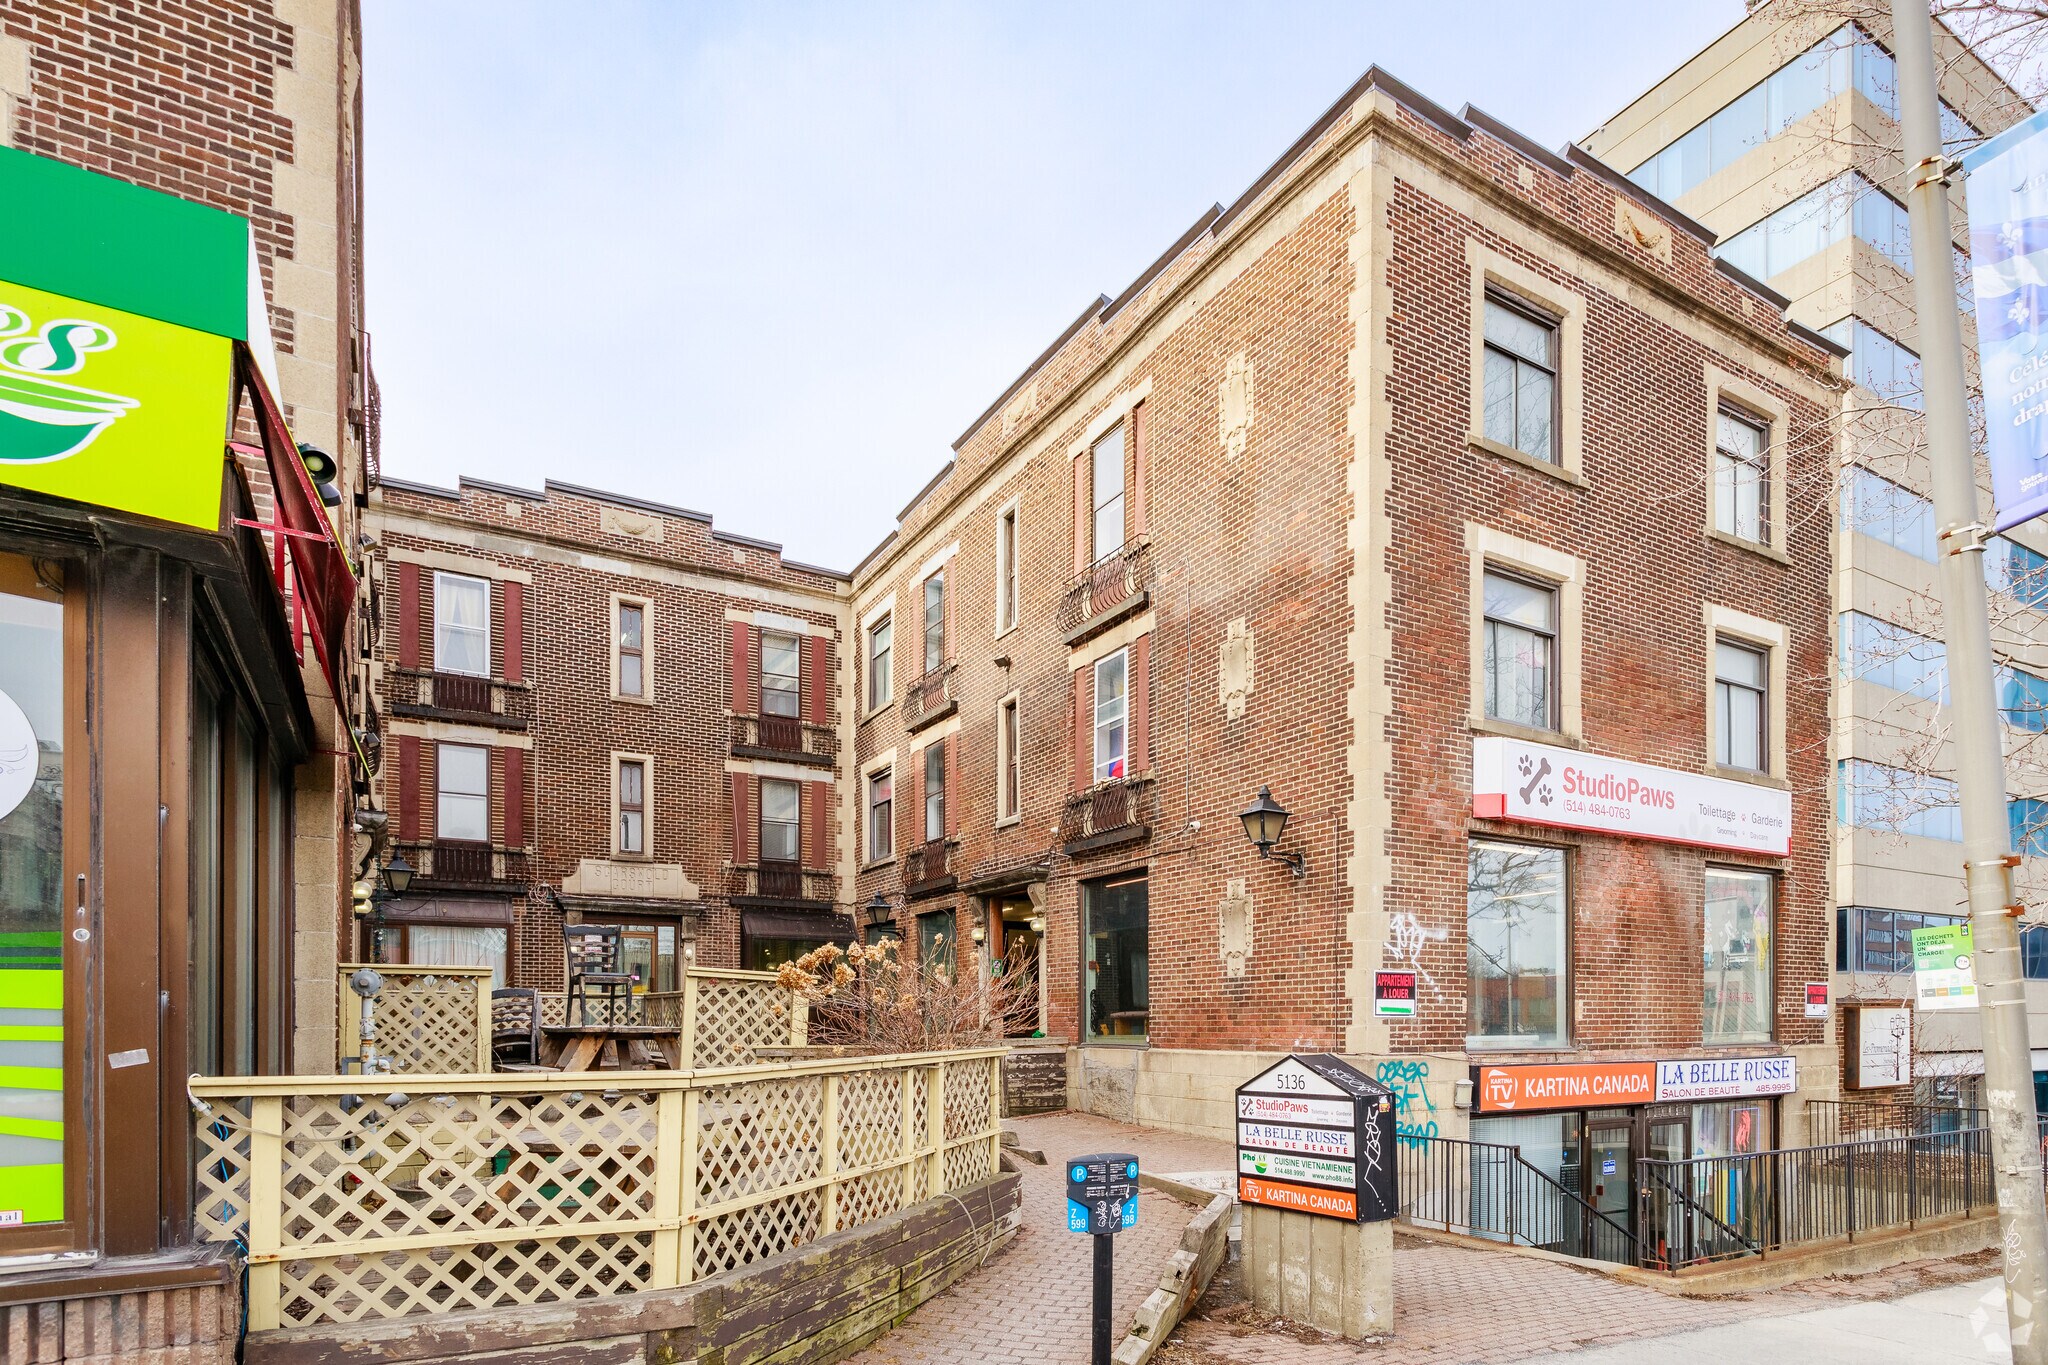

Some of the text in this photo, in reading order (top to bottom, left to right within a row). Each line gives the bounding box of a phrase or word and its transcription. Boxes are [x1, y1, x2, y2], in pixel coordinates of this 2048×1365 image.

[1562, 766, 1675, 809] StudioPaws
[1563, 800, 1631, 820] (514) 484-0763
[1699, 803, 1783, 828] Toilettage Garderie
[1377, 974, 1415, 987] APPARTEMENT
[1388, 988, 1409, 998] LOUER
[1662, 1060, 1790, 1085] LA BELLE RUSSE
[1277, 1074, 1306, 1090] 5136
[1525, 1074, 1649, 1098] KARTINA CANADA
[1490, 1085, 1513, 1101] TV
[1662, 1088, 1692, 1098] SALON
[1695, 1087, 1706, 1096] DE
[1256, 1098, 1309, 1114] StudioPaws
[1245, 1125, 1348, 1146] LA BELLE RUSSE
[1245, 1138, 1348, 1154] SALON DE BEAUTÉ
[1274, 1157, 1353, 1174] CUISINE VIETNAMIENNE
[1312, 1173, 1354, 1184] www.pho88.info
[1247, 1188, 1259, 1198] TV
[1266, 1188, 1354, 1213] KARTINA CANADA
[1071, 1209, 1077, 1218] Z
[1071, 1219, 1086, 1229] 599
